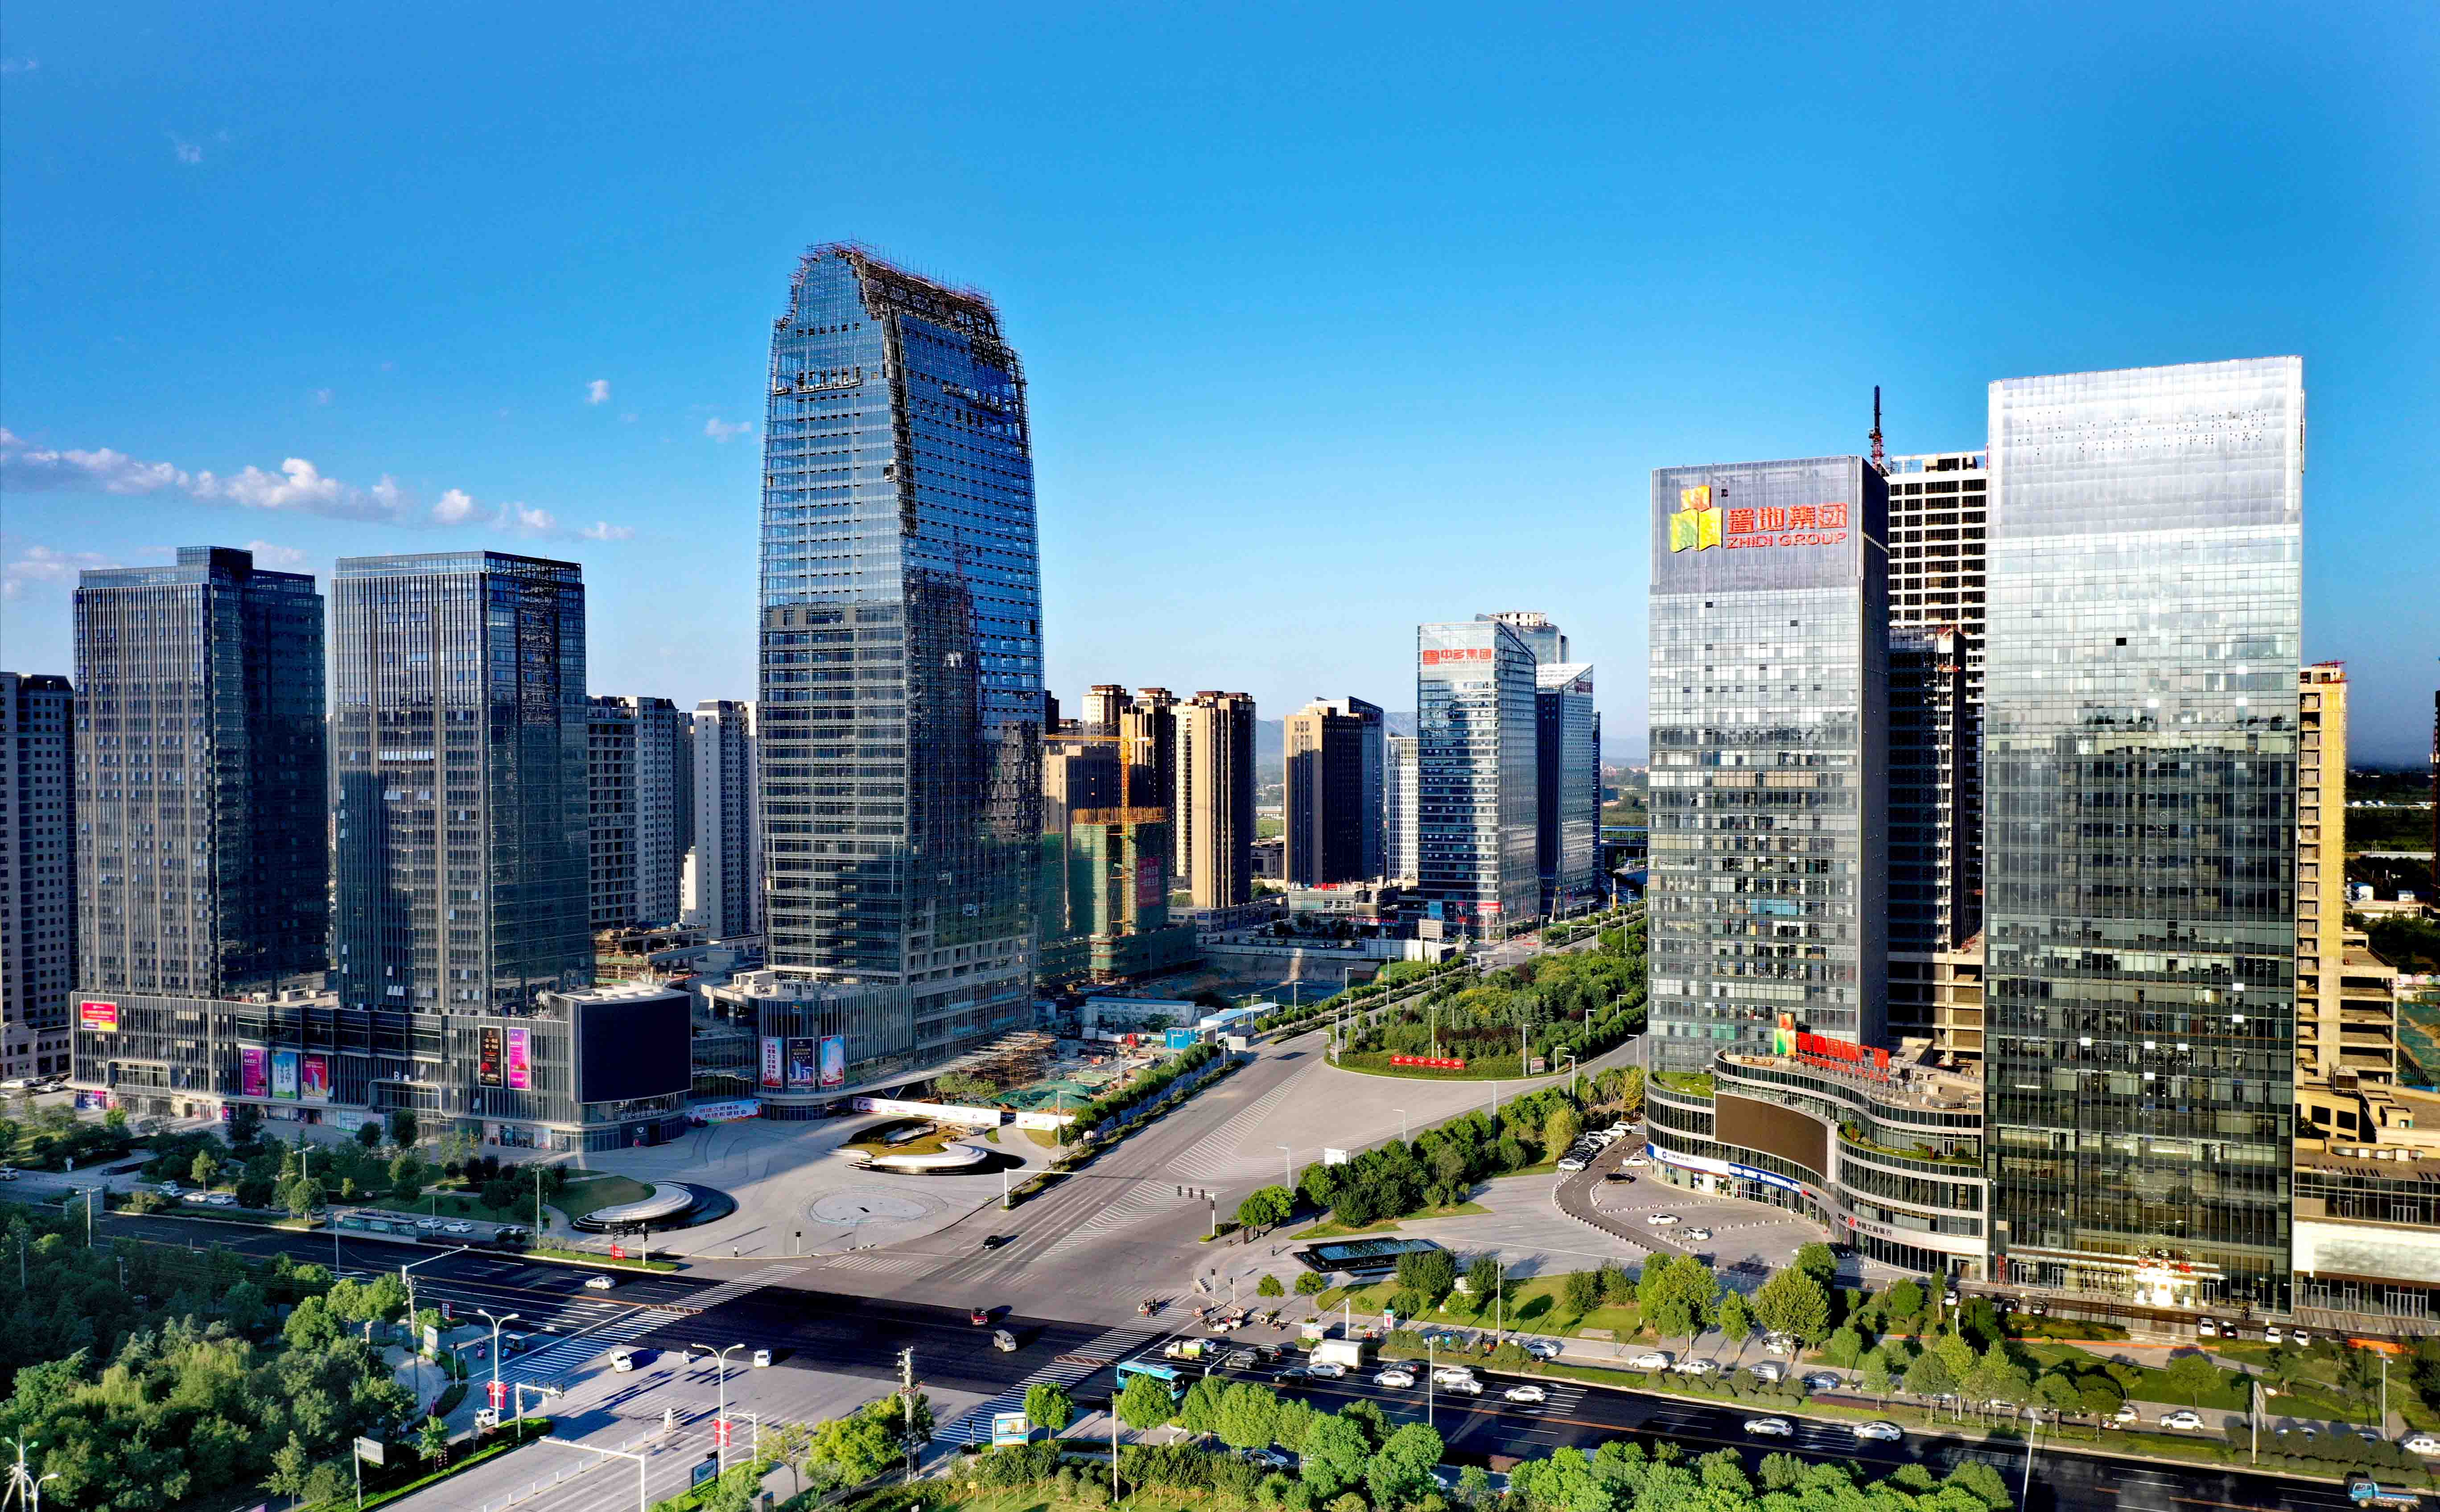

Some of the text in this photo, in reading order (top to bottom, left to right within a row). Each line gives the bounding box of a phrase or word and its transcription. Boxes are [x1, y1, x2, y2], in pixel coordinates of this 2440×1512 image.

[1727, 502, 1847, 534] 置地集团
[1726, 532, 1847, 549] ZHIDI GROUP
[1797, 1031, 1890, 1069] 置地国际广场
[1856, 1221, 1893, 1236] 中国工商银行
